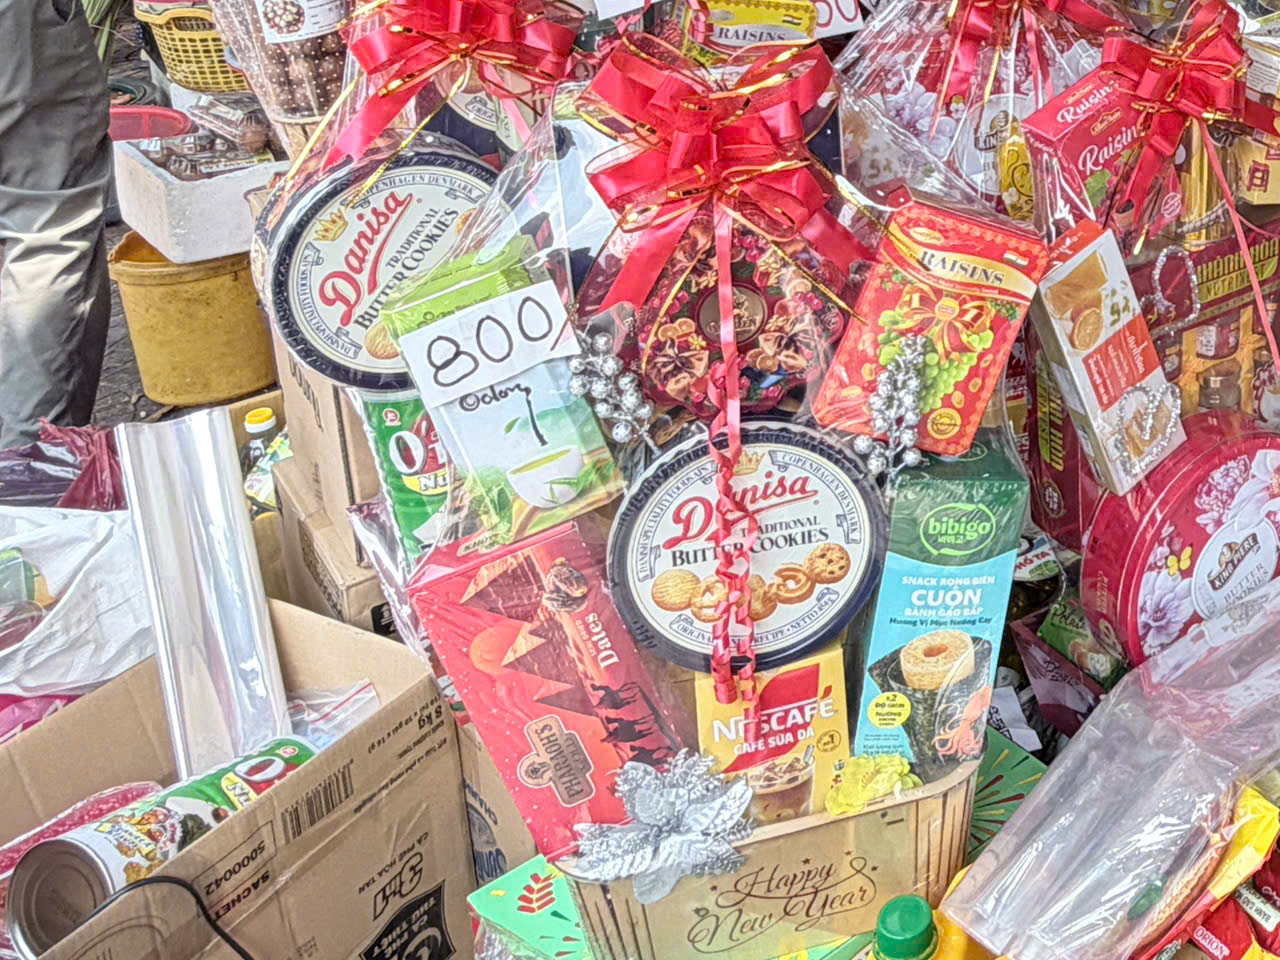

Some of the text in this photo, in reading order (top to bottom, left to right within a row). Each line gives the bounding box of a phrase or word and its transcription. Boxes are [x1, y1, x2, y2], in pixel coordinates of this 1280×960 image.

[717, 26, 786, 43] RAISINS
[1078, 124, 1143, 174] Raisin
[319, 189, 415, 329] Danisa
[385, 206, 443, 271] TRADITIONAL
[352, 207, 459, 332] BUTTER COOKIES
[918, 249, 1006, 286] RAISINS
[426, 294, 554, 388] 800
[663, 471, 819, 551] Dnisa
[781, 452, 859, 535] COPENHAGEN DENMARK
[749, 527, 830, 554] COOKIES
[928, 517, 992, 540] bibigo
[901, 575, 938, 586] SNACK
[584, 611, 620, 670] Dates
[533, 720, 588, 799] PHARAOH'S
[204, 839, 267, 896] 5000042
[715, 859, 838, 908] Happy
[210, 870, 270, 923] SACHET
[784, 879, 872, 930] Year
[688, 906, 775, 954] New
[1193, 926, 1231, 960] ORION
